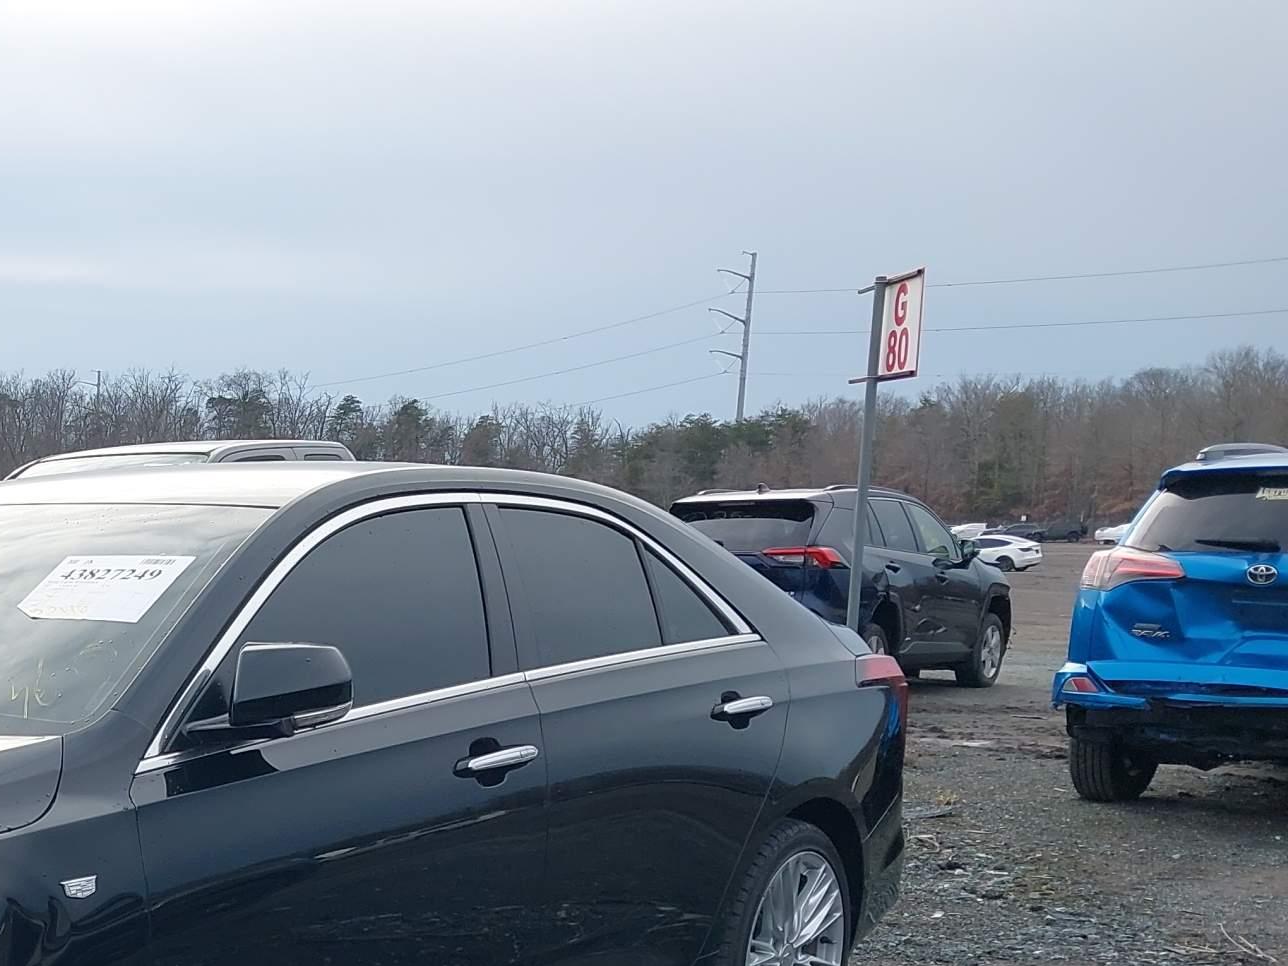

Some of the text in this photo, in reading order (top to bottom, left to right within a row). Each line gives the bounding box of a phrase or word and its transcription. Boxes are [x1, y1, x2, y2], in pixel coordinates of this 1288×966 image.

[894, 282, 909, 326] G
[886, 327, 909, 372] 80
[60, 568, 163, 580] 43827249
